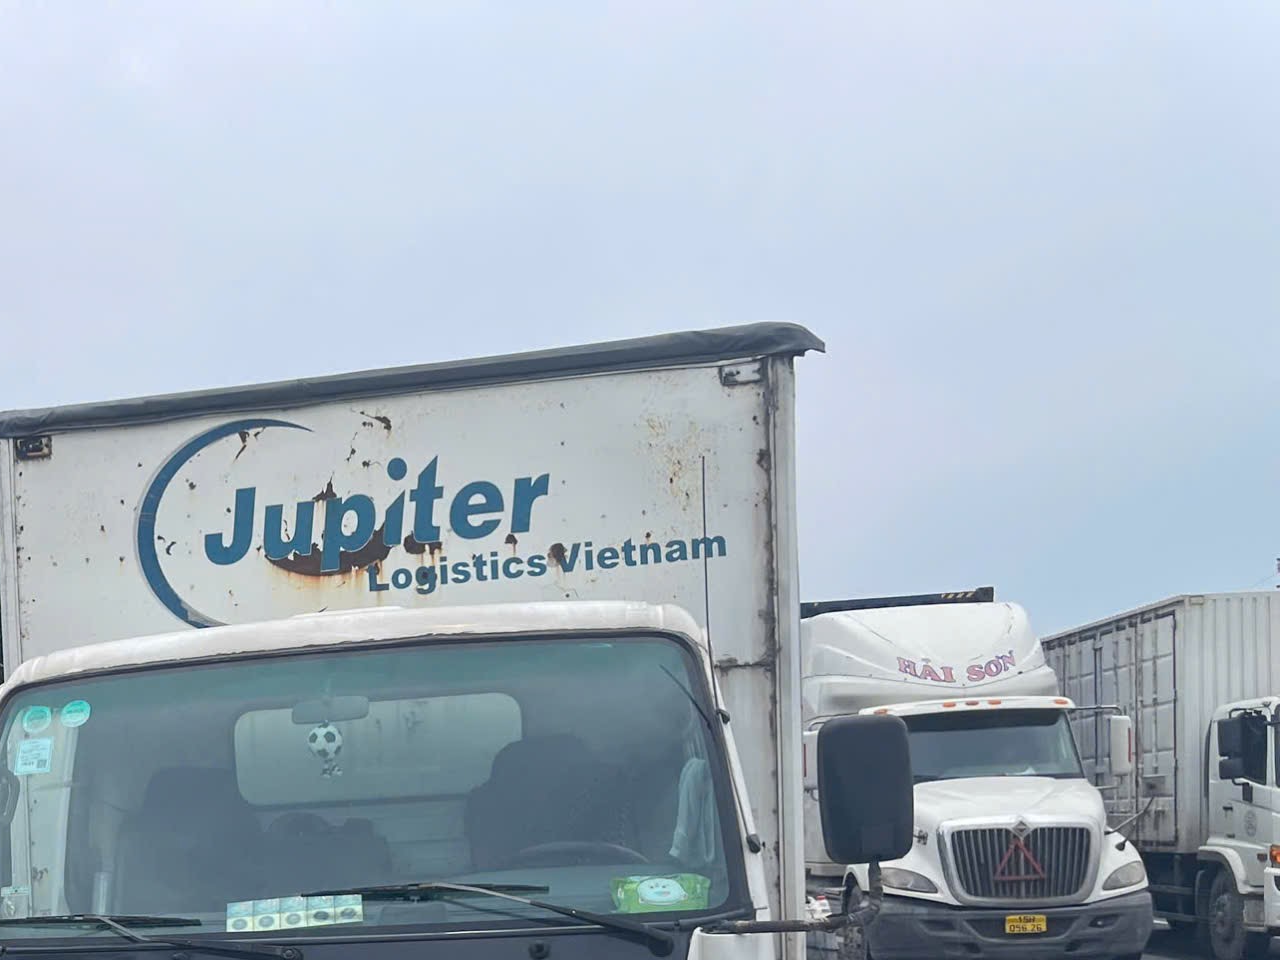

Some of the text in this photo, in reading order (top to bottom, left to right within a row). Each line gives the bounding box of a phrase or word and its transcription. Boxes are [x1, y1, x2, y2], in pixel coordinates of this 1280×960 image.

[204, 455, 550, 573] Jupiter
[368, 535, 728, 595] Logistics Vietnam
